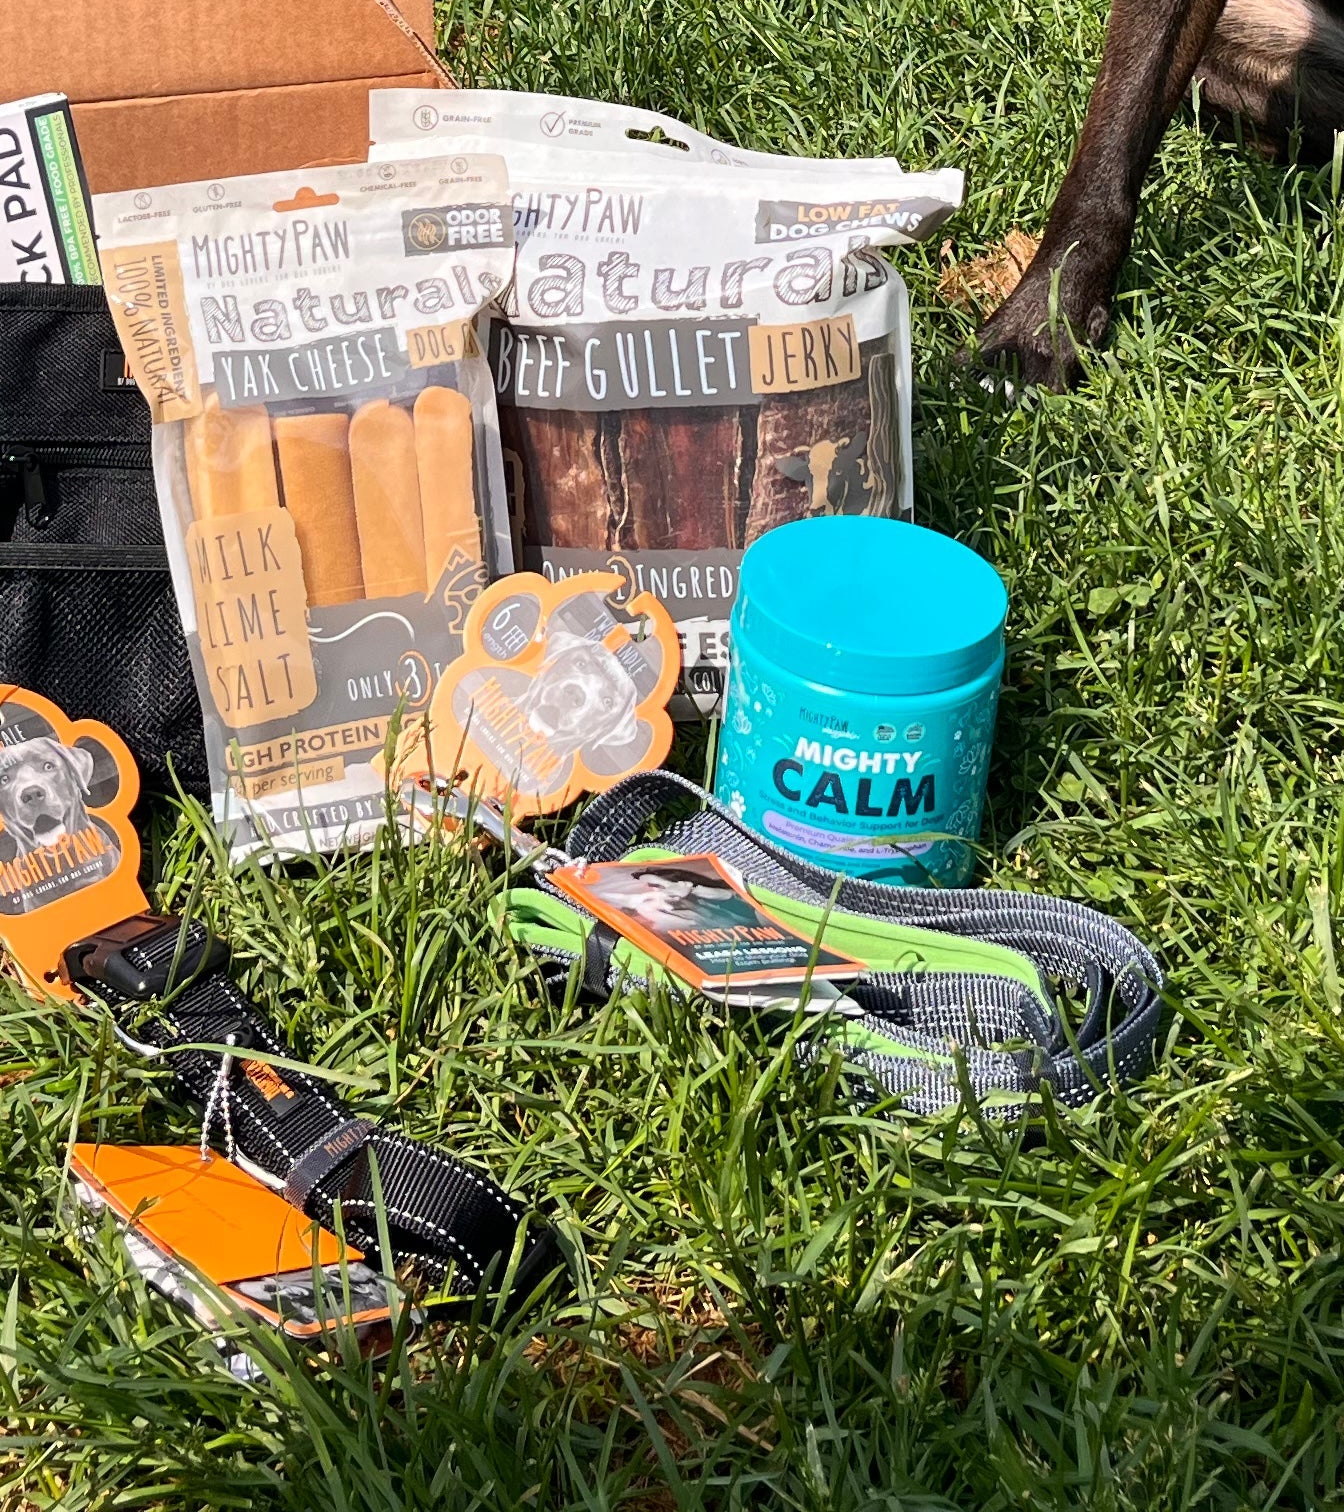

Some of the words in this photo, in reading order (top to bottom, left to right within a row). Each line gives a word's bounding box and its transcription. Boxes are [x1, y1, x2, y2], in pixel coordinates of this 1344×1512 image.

[38, 118, 56, 159] GRADE
[53, 114, 77, 196] PROFESSIONALS
[49, 161, 65, 195] FOOD
[61, 207, 74, 235] FREE
[71, 196, 82, 209] BY
[446, 208, 502, 226] ODOR
[797, 204, 852, 223] LOW
[858, 202, 901, 218] FAT
[447, 222, 504, 246] FREE
[769, 223, 831, 241] DOG
[835, 211, 923, 233] CHEWS
[66, 236, 79, 260] BPA
[76, 209, 100, 286] ECOMMENDED
[191, 219, 350, 279] MIGHTYPAW
[114, 256, 153, 318] 100%
[151, 254, 170, 309] LIMITED
[199, 264, 505, 344] Naturals
[220, 350, 281, 401] YAK
[288, 332, 394, 394] CHEESE
[413, 326, 456, 362] DOG
[497, 327, 570, 399] BEEF
[584, 328, 742, 400] GULLET
[761, 321, 855, 387] JERKY
[194, 523, 282, 586] MILK
[204, 589, 288, 650] LIME
[492, 602, 521, 631] 6
[215, 653, 296, 714] SALT
[347, 669, 394, 702] ONLY
[404, 657, 422, 699] 3
[280, 722, 381, 759] PROTEIN
[793, 736, 923, 775] MIGHTY
[252, 775, 276, 796] per
[280, 764, 336, 789] serving
[772, 757, 936, 818] CALM
[356, 799, 375, 819] BY
[808, 811, 856, 829] Behavior
[859, 820, 902, 832] Support
